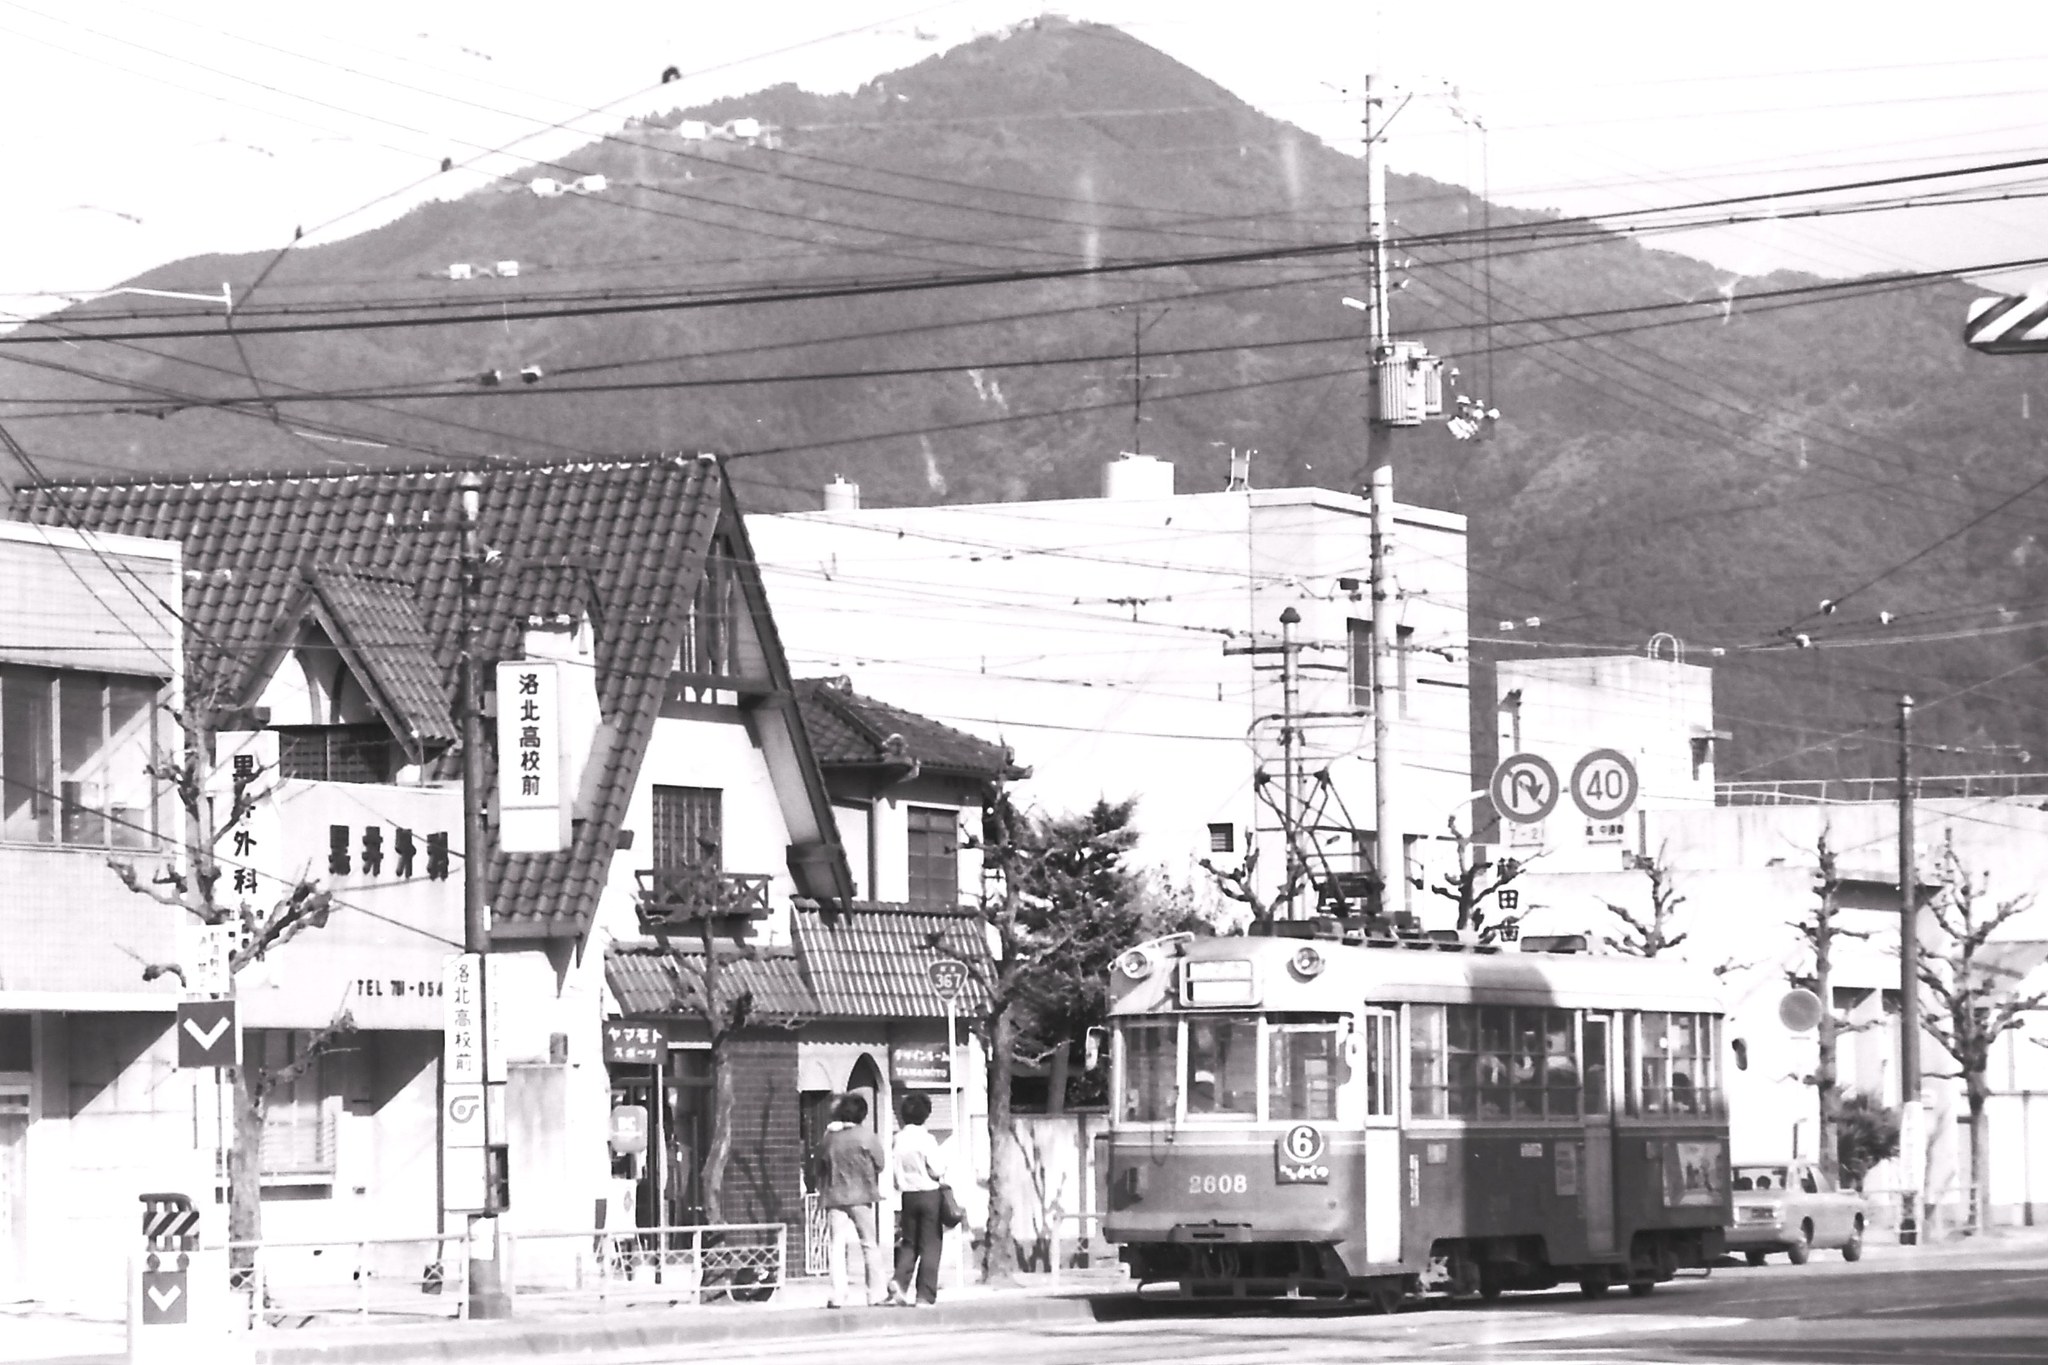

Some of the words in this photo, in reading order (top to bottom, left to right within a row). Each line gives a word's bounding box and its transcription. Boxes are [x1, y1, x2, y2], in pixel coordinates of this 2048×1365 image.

[519, 673, 541, 796] 洛北高校前
[1586, 769, 1623, 800] 40
[357, 979, 383, 996] TEL
[935, 973, 962, 989] 367
[454, 964, 472, 1071] 洛北高校前
[608, 1027, 662, 1044] ヤマモト
[895, 1067, 948, 1078] YAMAMOTO
[1292, 1126, 1314, 1158] 6
[1189, 1174, 1248, 1194] 2608
